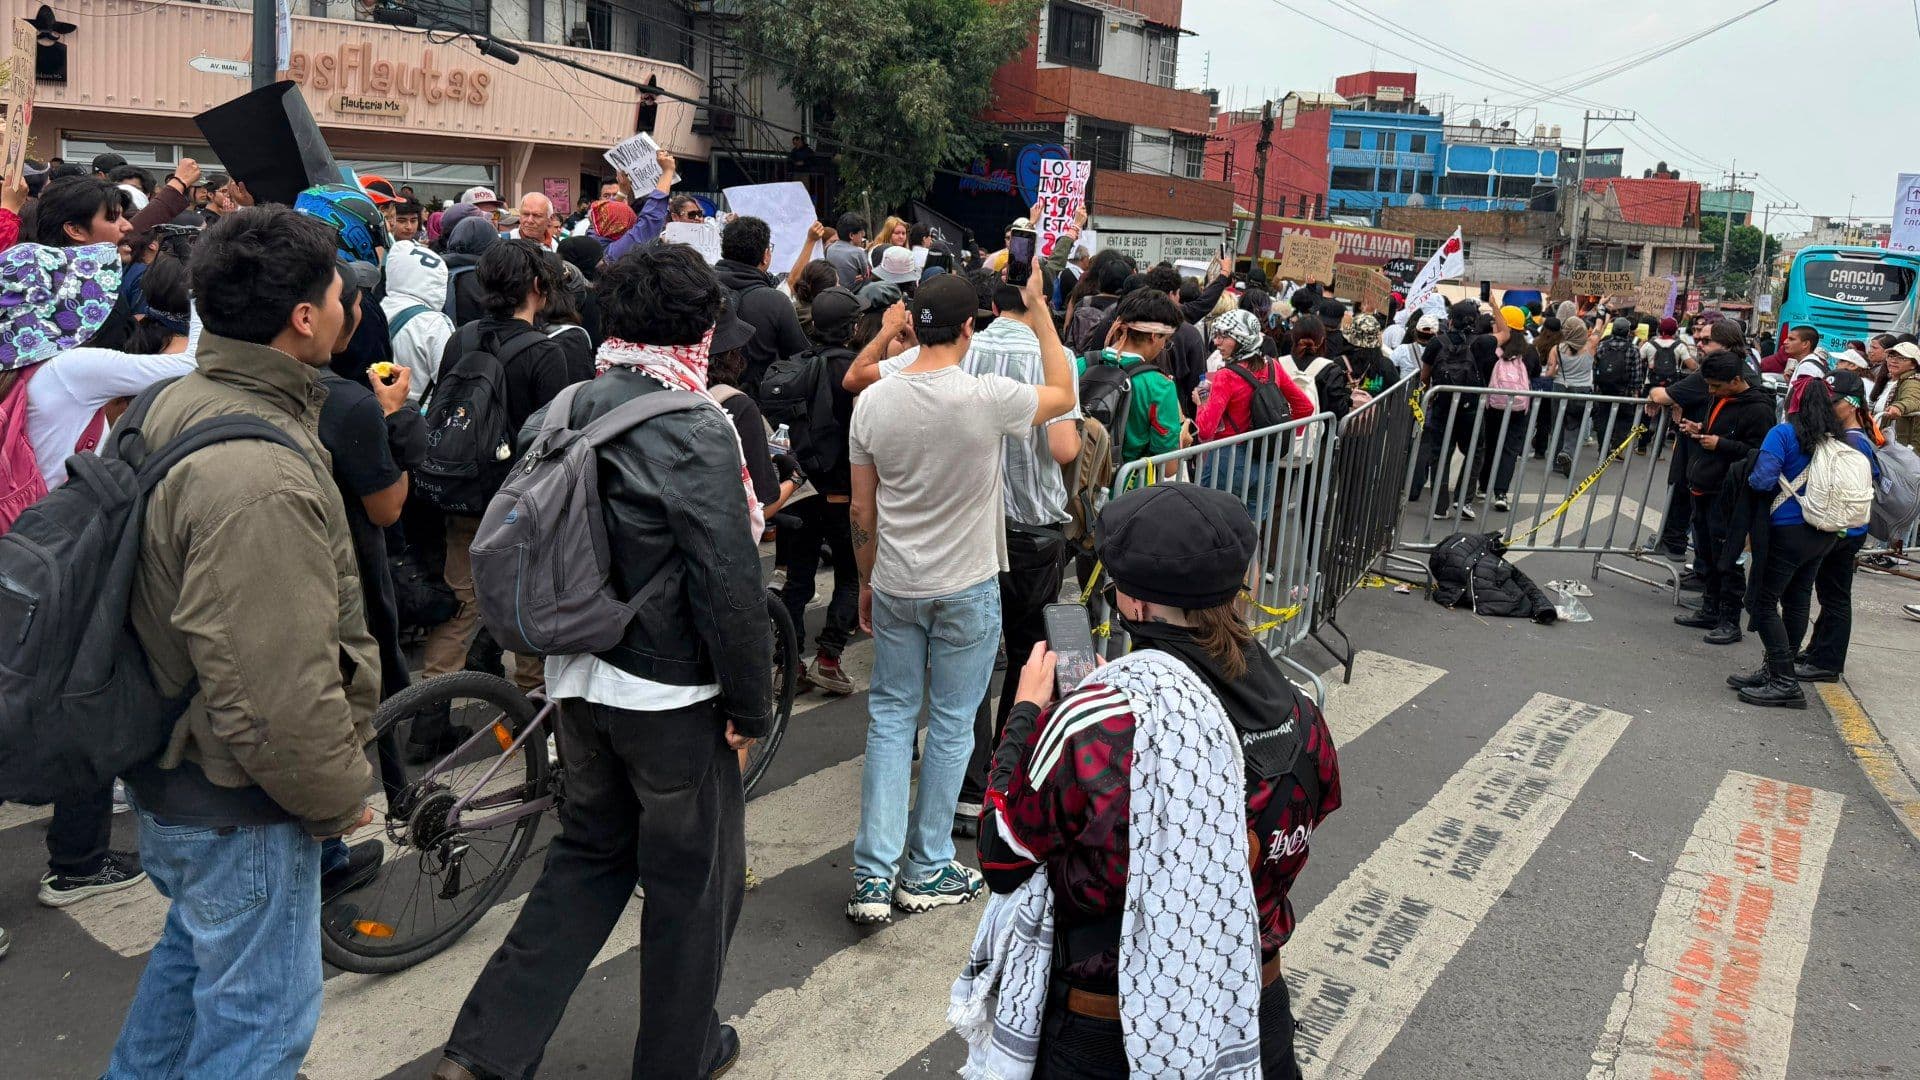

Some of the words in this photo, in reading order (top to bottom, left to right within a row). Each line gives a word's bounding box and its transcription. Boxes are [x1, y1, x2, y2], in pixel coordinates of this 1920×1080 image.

[1043, 160, 1072, 178] LOS
[1106, 236, 1122, 246] VENTA
[1123, 236, 1131, 246] DE
[1829, 269, 1885, 286] CANCÚN
[1828, 282, 1883, 291] DISCOVERY
